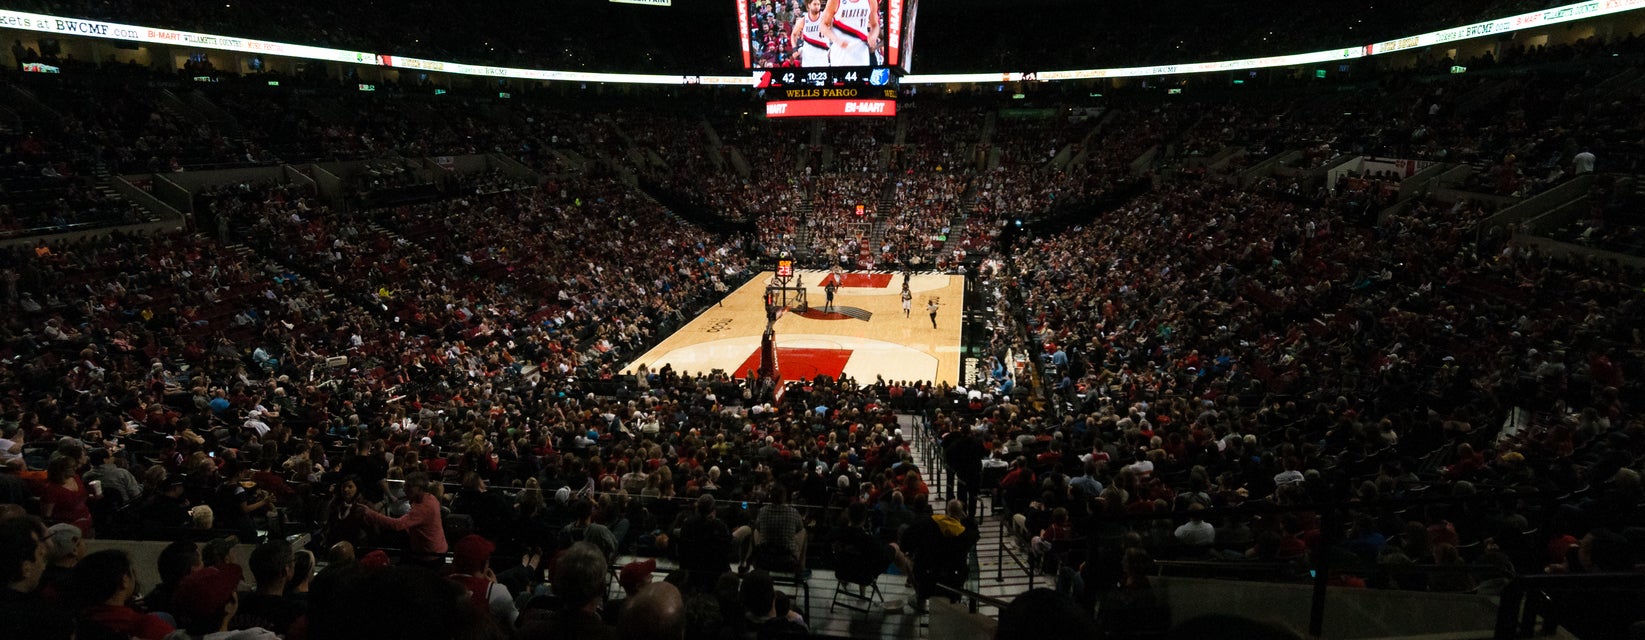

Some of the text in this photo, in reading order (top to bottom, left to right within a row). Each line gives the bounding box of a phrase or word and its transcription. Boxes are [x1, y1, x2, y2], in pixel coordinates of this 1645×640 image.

[147, 30, 181, 41] BI-MART
[782, 72, 795, 83] 42
[807, 72, 828, 81] 10:23
[845, 71, 858, 82] 44
[786, 88, 858, 98] WELLS FARGO
[844, 102, 886, 113] BI-MART
[778, 267, 790, 276] 23
